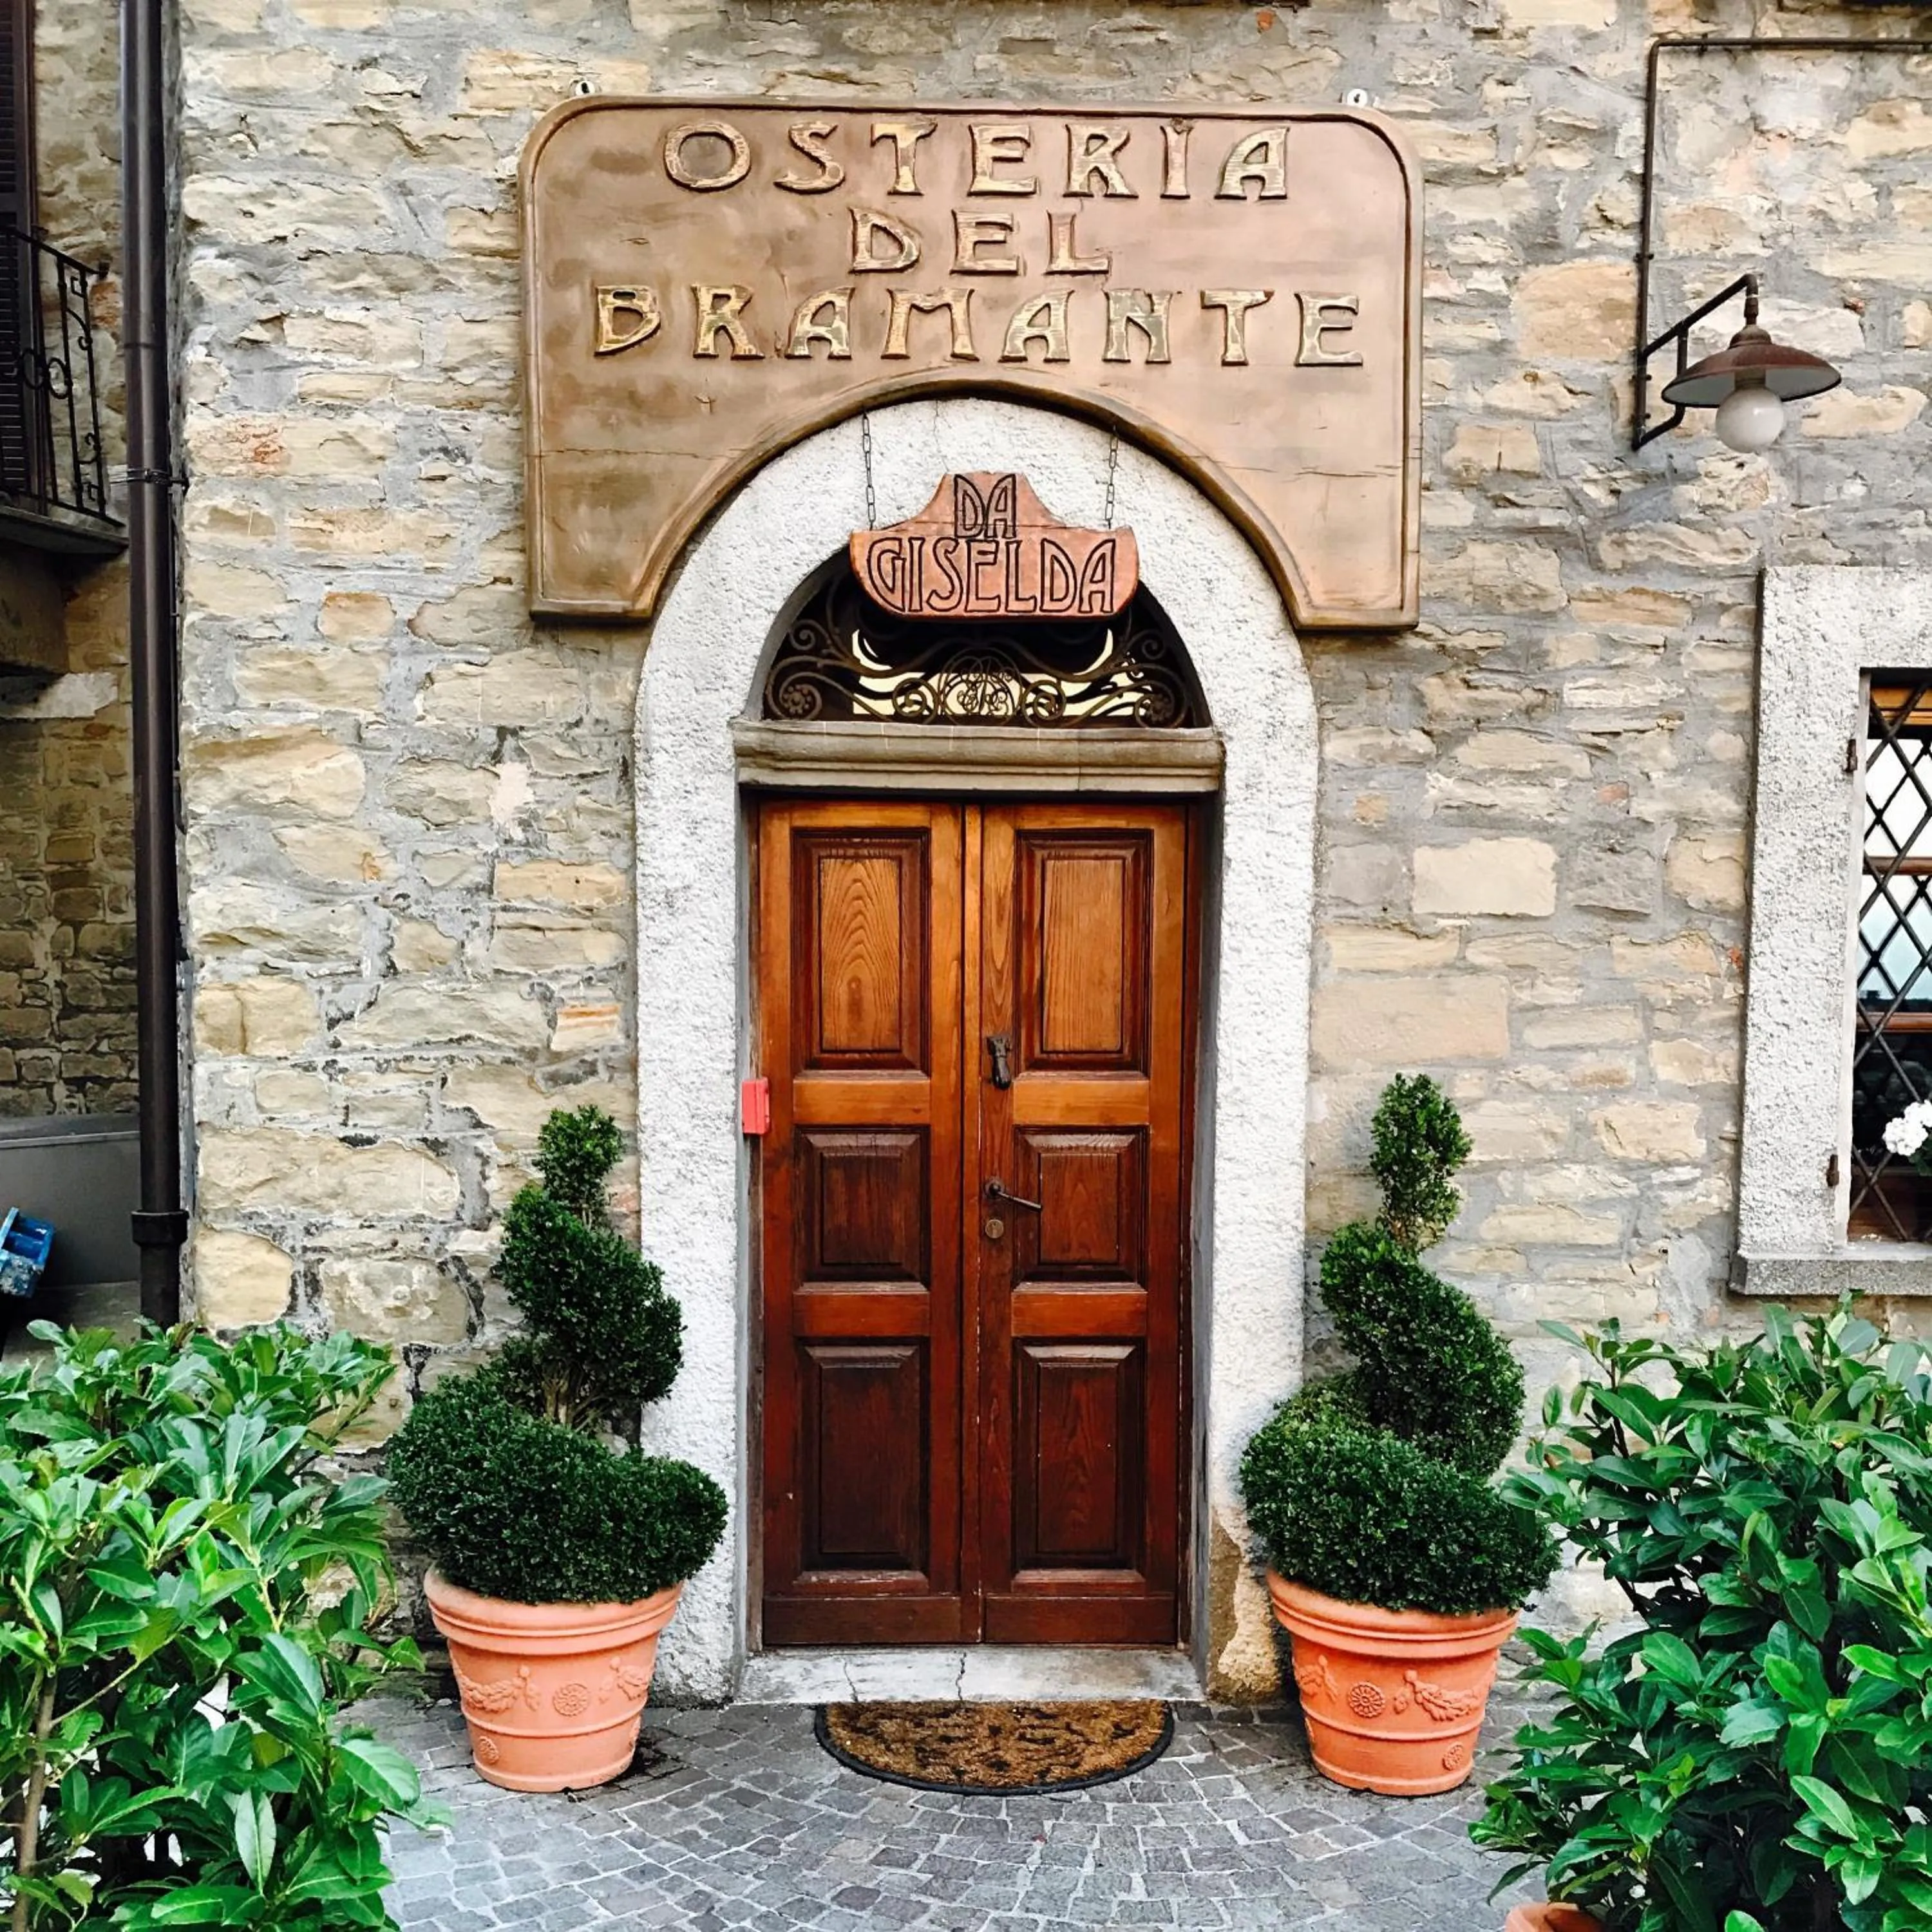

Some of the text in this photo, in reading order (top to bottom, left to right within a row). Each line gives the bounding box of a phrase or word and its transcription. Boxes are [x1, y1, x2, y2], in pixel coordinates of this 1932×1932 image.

[663, 120, 1290, 200] OSTERIA
[849, 207, 1112, 276] DEL
[593, 285, 1363, 366] BRAMANTE
[954, 474, 1017, 538] DA
[867, 537, 1117, 612] GISELDA
